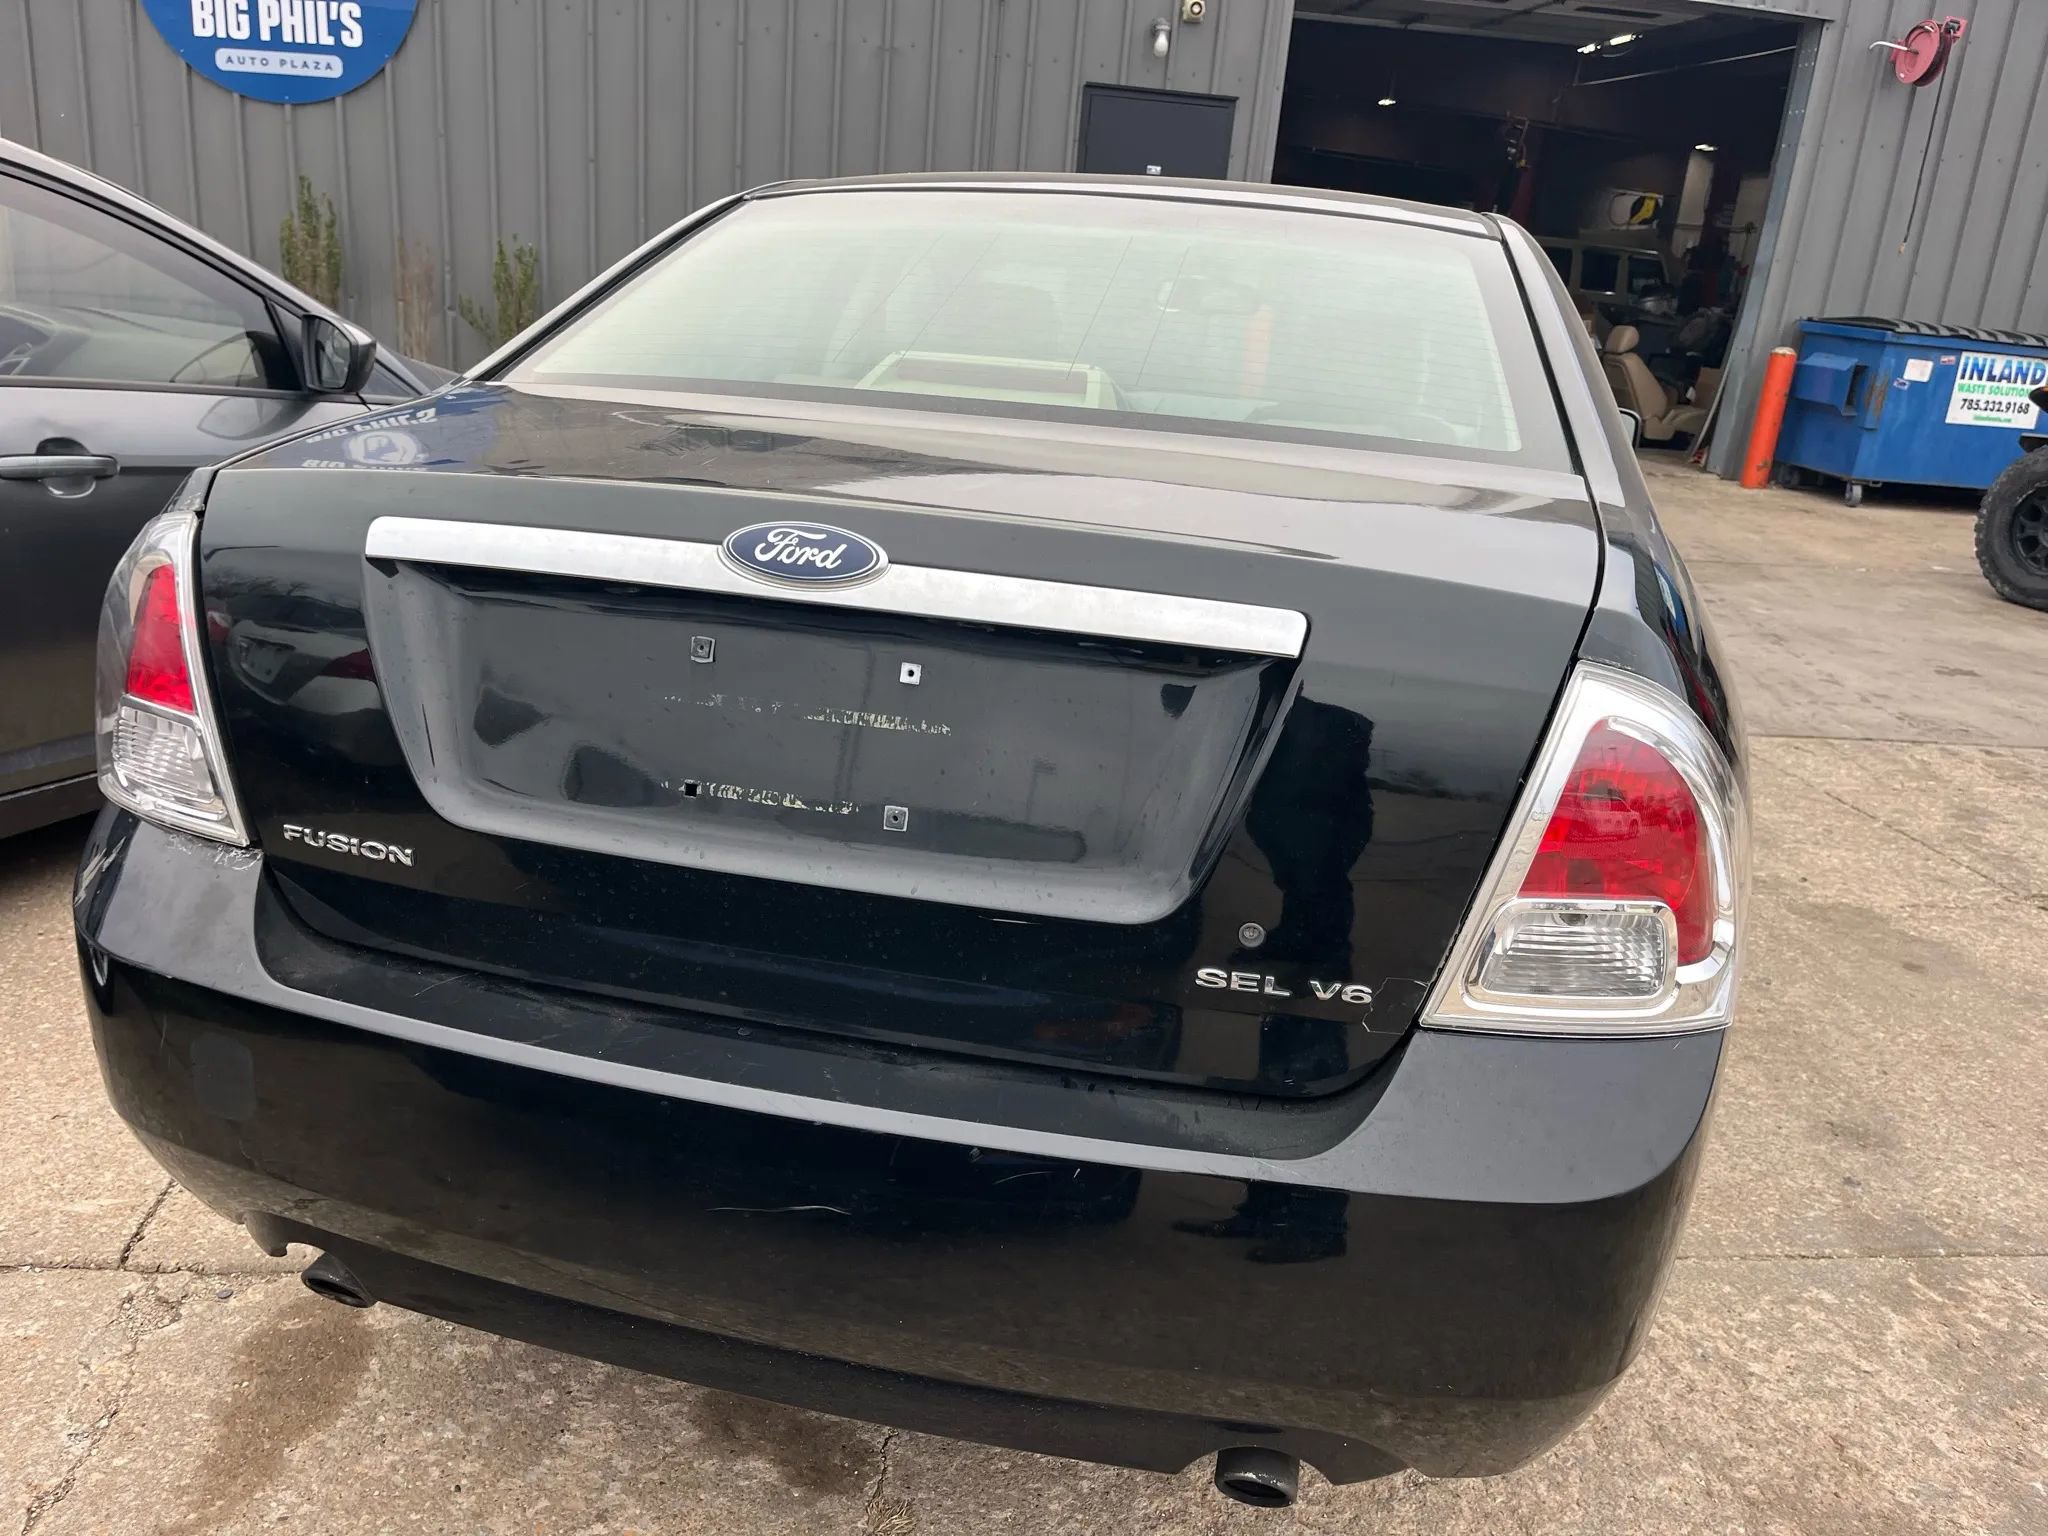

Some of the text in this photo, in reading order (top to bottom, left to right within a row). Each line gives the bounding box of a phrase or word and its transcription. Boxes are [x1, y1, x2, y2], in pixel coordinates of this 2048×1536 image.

[191, 0, 363, 47] BIG PHIL'S
[225, 56, 333, 71] AUTO PLAZA
[1959, 355, 2047, 386] INLAND
[1957, 383, 1987, 395] WASTE
[1960, 398, 2030, 415] 785.232.9168
[754, 528, 848, 570] Ford
[283, 824, 415, 867] FUSION
[1195, 967, 1373, 1004] SEL V6
